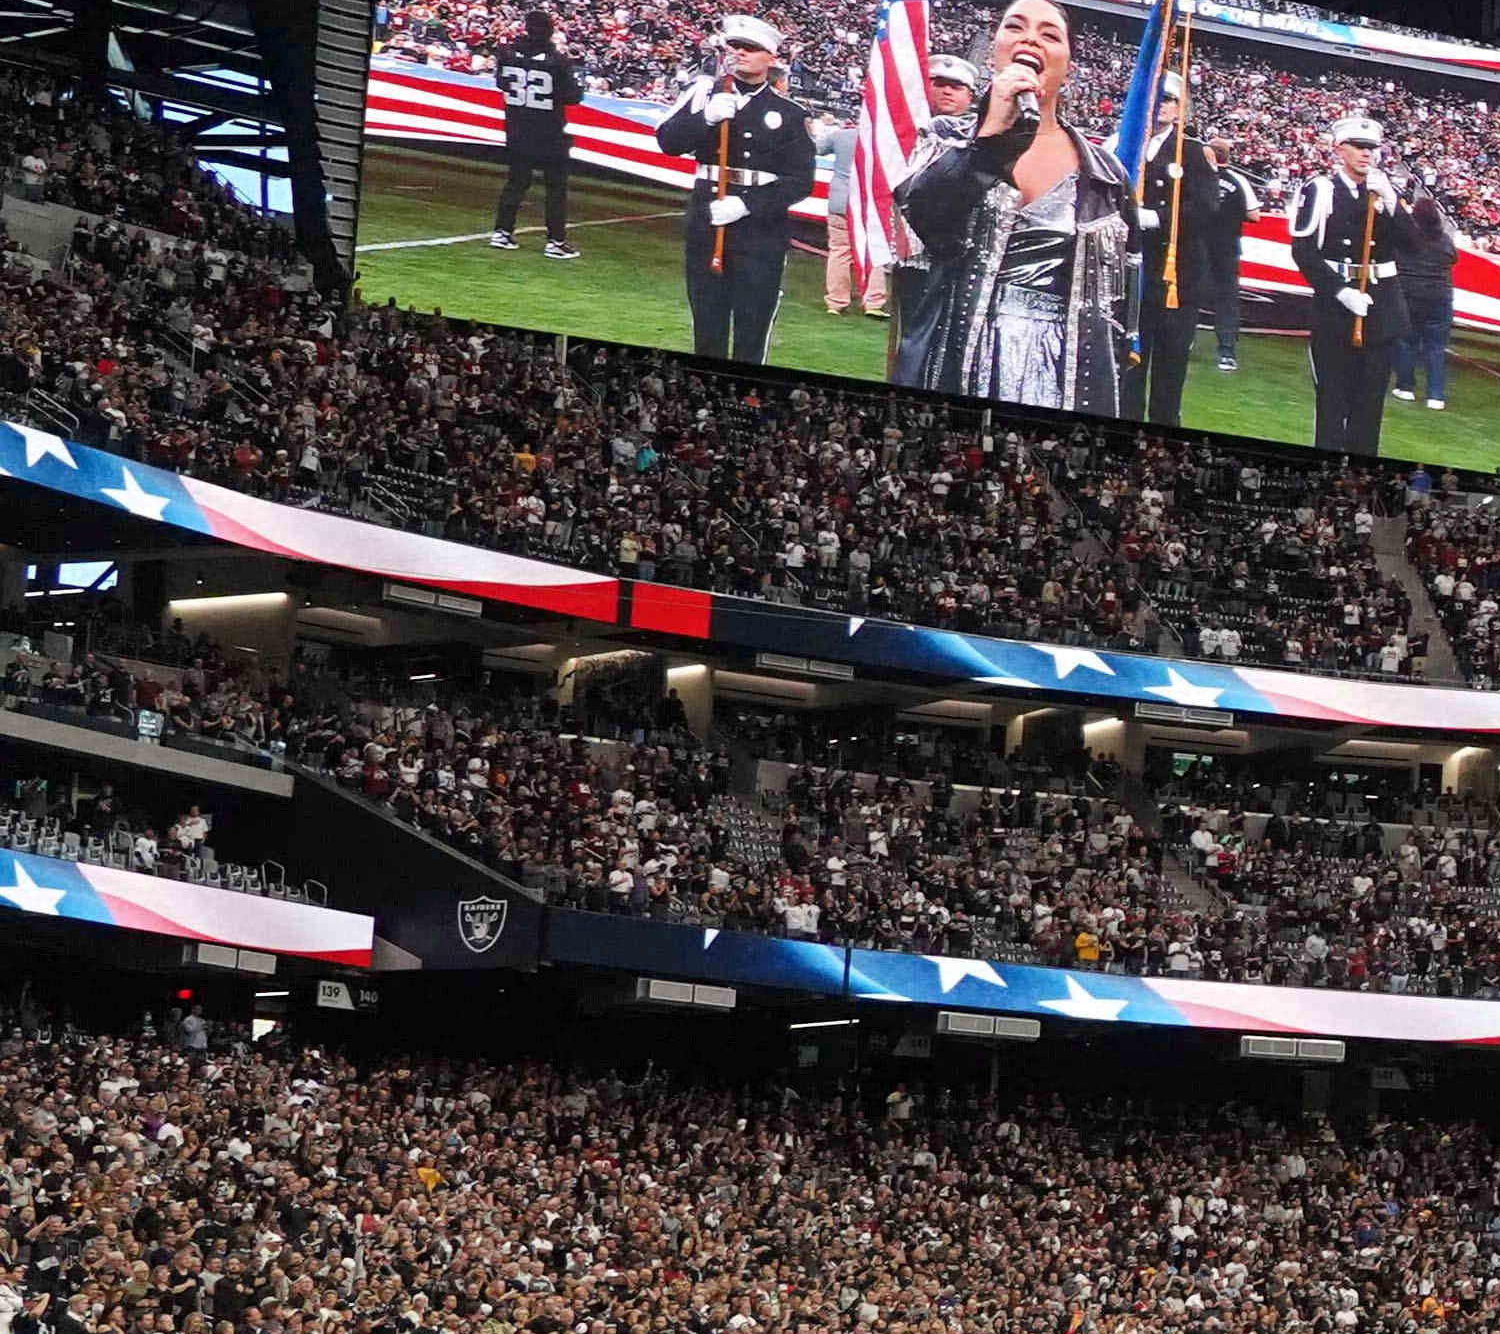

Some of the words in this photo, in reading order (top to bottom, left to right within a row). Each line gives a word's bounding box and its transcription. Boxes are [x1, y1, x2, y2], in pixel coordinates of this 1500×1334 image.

[502, 66, 553, 110] 32
[463, 903, 501, 912] RAIDERS
[322, 985, 340, 999] 139
[360, 989, 378, 1003] 140
